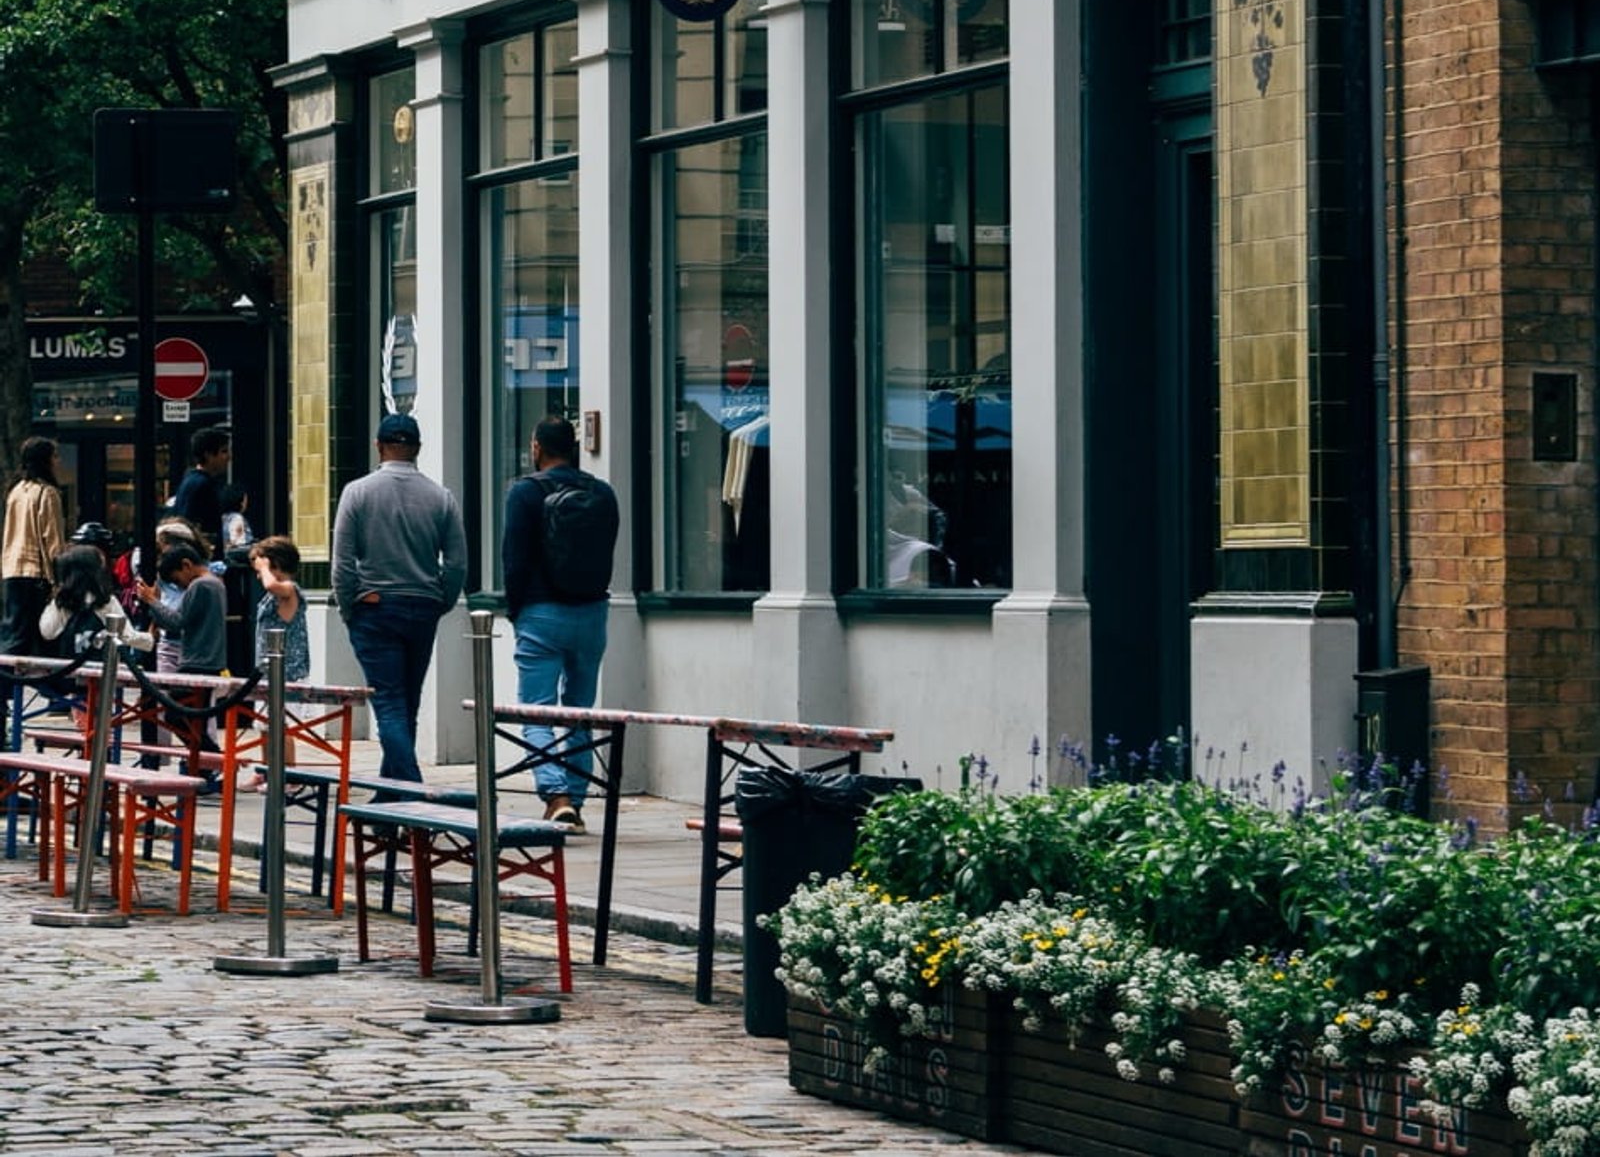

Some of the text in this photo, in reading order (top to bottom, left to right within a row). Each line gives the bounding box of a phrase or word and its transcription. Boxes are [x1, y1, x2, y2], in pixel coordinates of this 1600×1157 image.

[30, 337, 126, 358] LUMAS
[823, 1024, 953, 1116] DIALS
[1282, 1040, 1468, 1155] SEVEN
